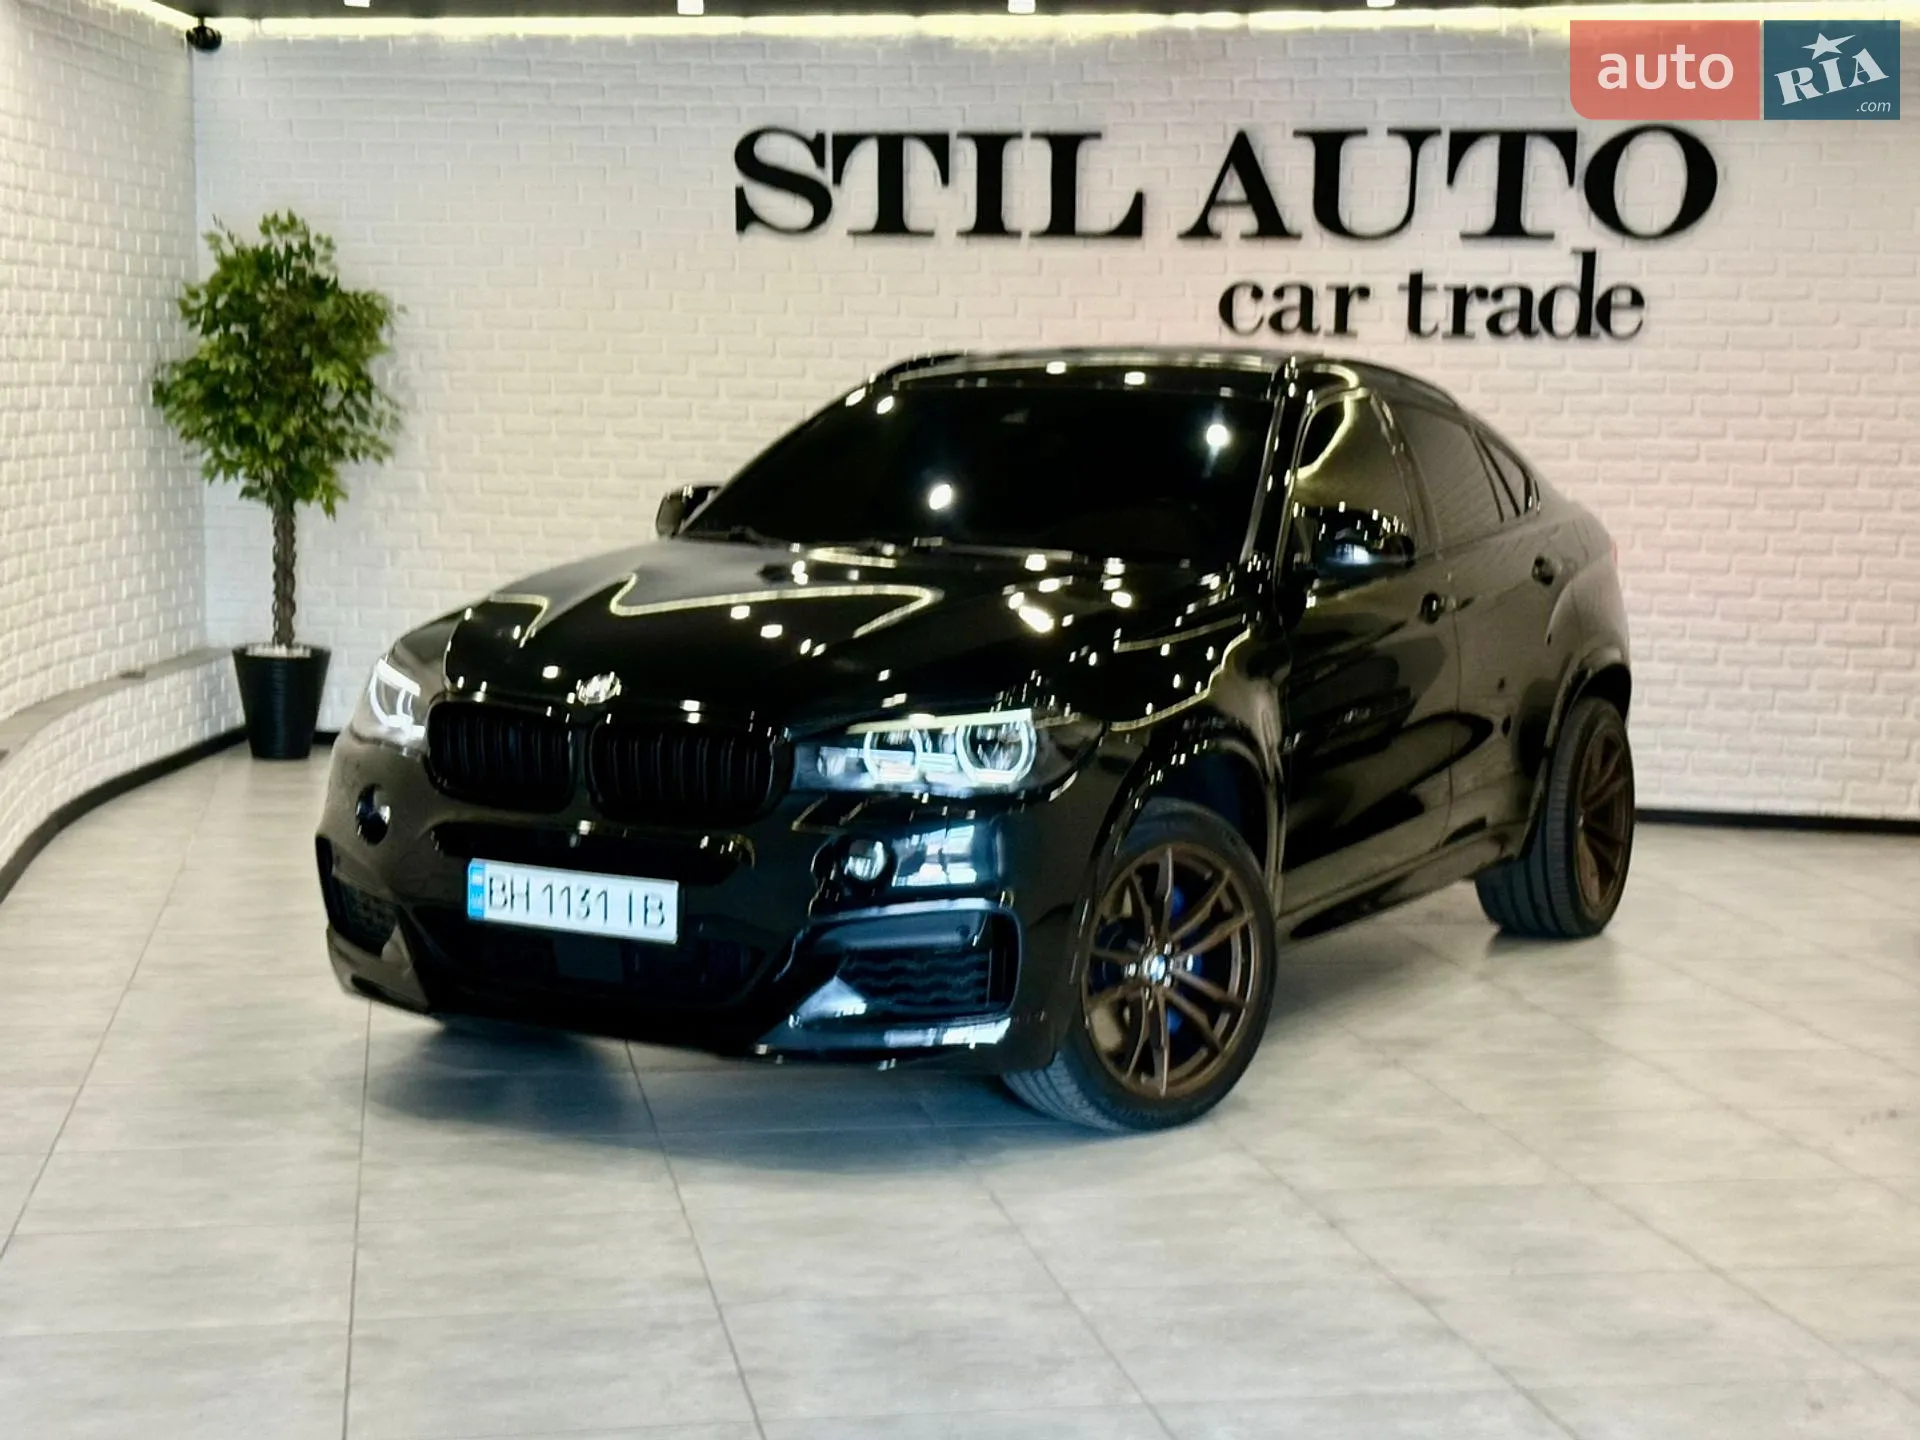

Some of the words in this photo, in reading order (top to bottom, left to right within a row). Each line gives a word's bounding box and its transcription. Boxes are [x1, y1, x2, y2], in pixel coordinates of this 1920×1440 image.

[734, 127, 1144, 238] STIL
[1177, 124, 1718, 240] AUTO
[1218, 280, 1370, 336] car
[1398, 248, 1645, 340] trade
[488, 875, 531, 914] BH
[541, 883, 610, 925] 1131
